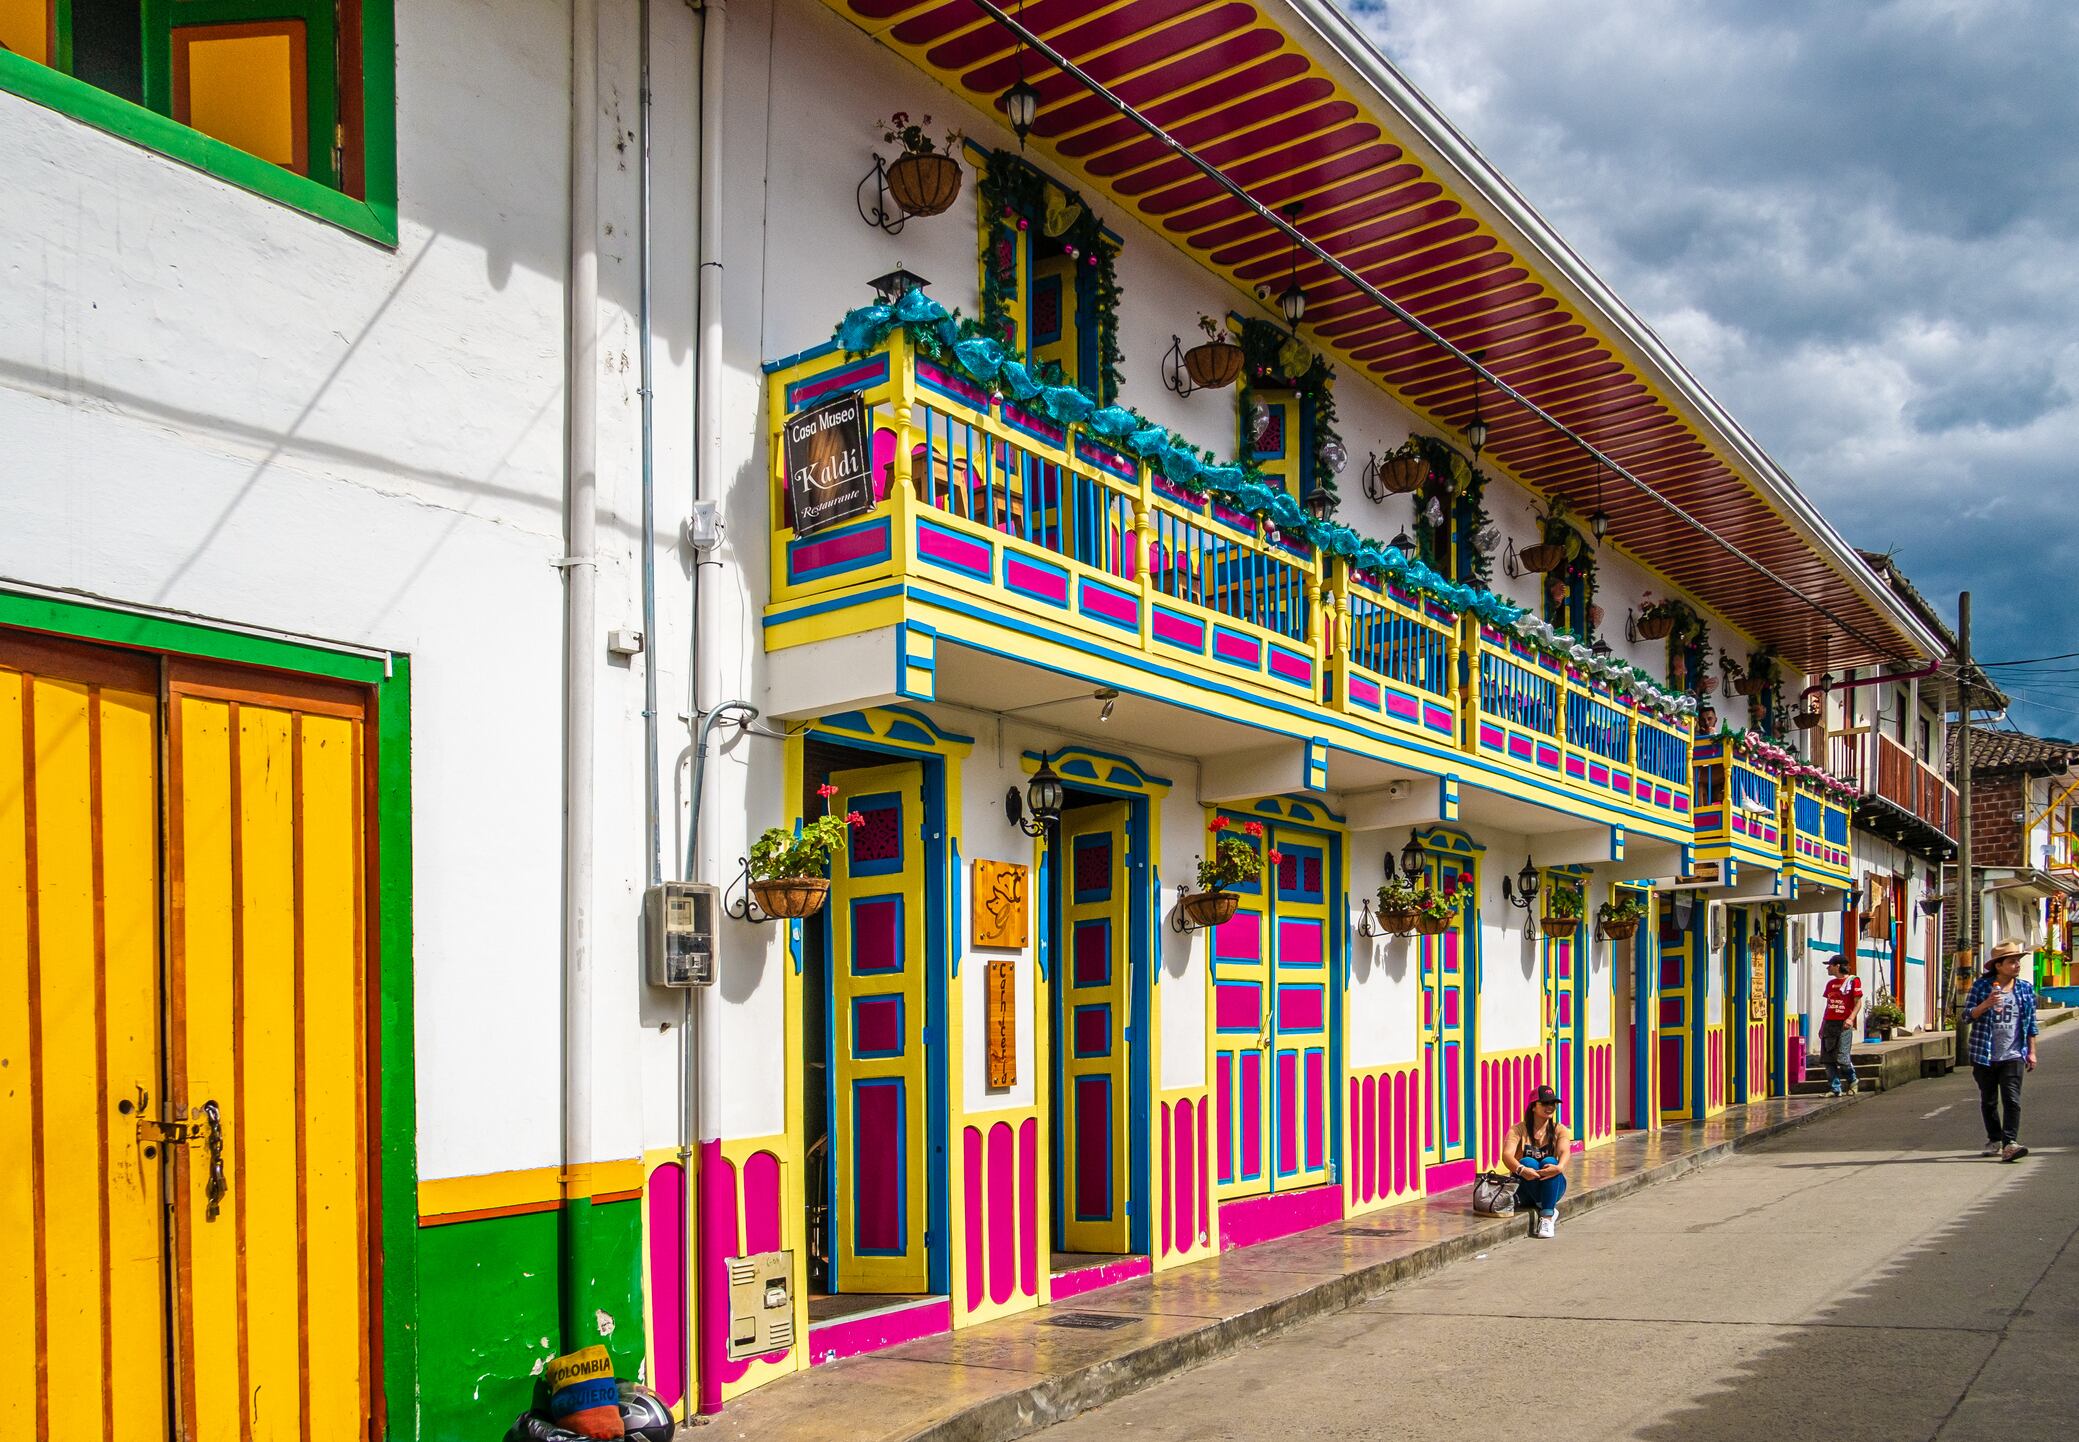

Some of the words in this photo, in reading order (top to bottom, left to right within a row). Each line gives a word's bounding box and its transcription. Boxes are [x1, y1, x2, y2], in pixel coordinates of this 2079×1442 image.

[792, 421, 817, 444] Casa
[818, 407, 855, 432] Museo
[800, 489, 861, 520] Restaurante
